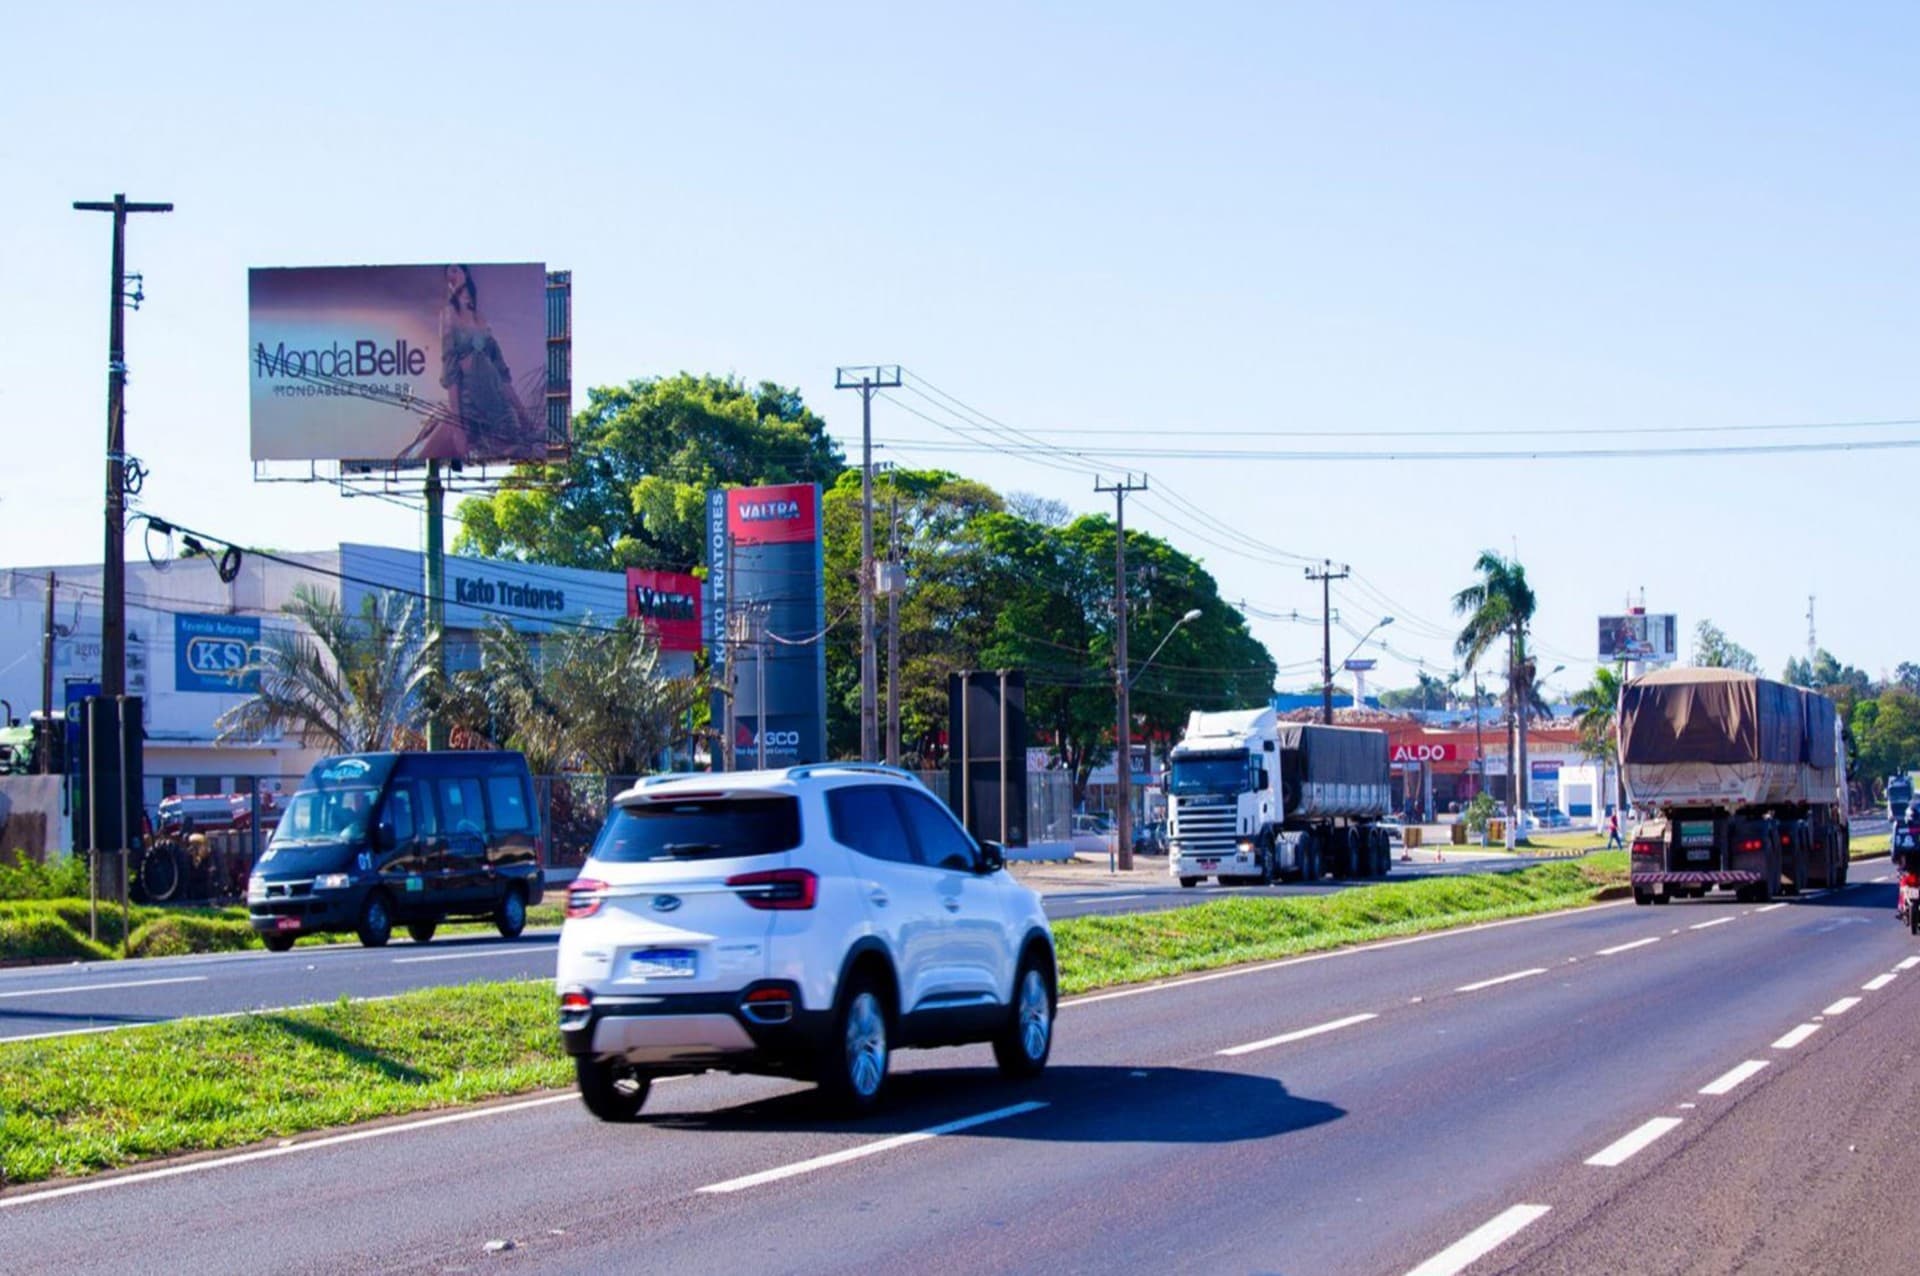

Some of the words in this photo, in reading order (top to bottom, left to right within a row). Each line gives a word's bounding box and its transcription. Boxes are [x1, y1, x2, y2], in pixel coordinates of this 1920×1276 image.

[257, 339, 426, 378] MondaBelle
[738, 501, 799, 521] VALTRA
[712, 493, 725, 601] TRATORES
[455, 577, 496, 605] Kato
[497, 580, 565, 611] Tratores
[714, 609, 726, 663] KATO
[195, 642, 242, 669] KS
[1393, 744, 1445, 761] ALDO
